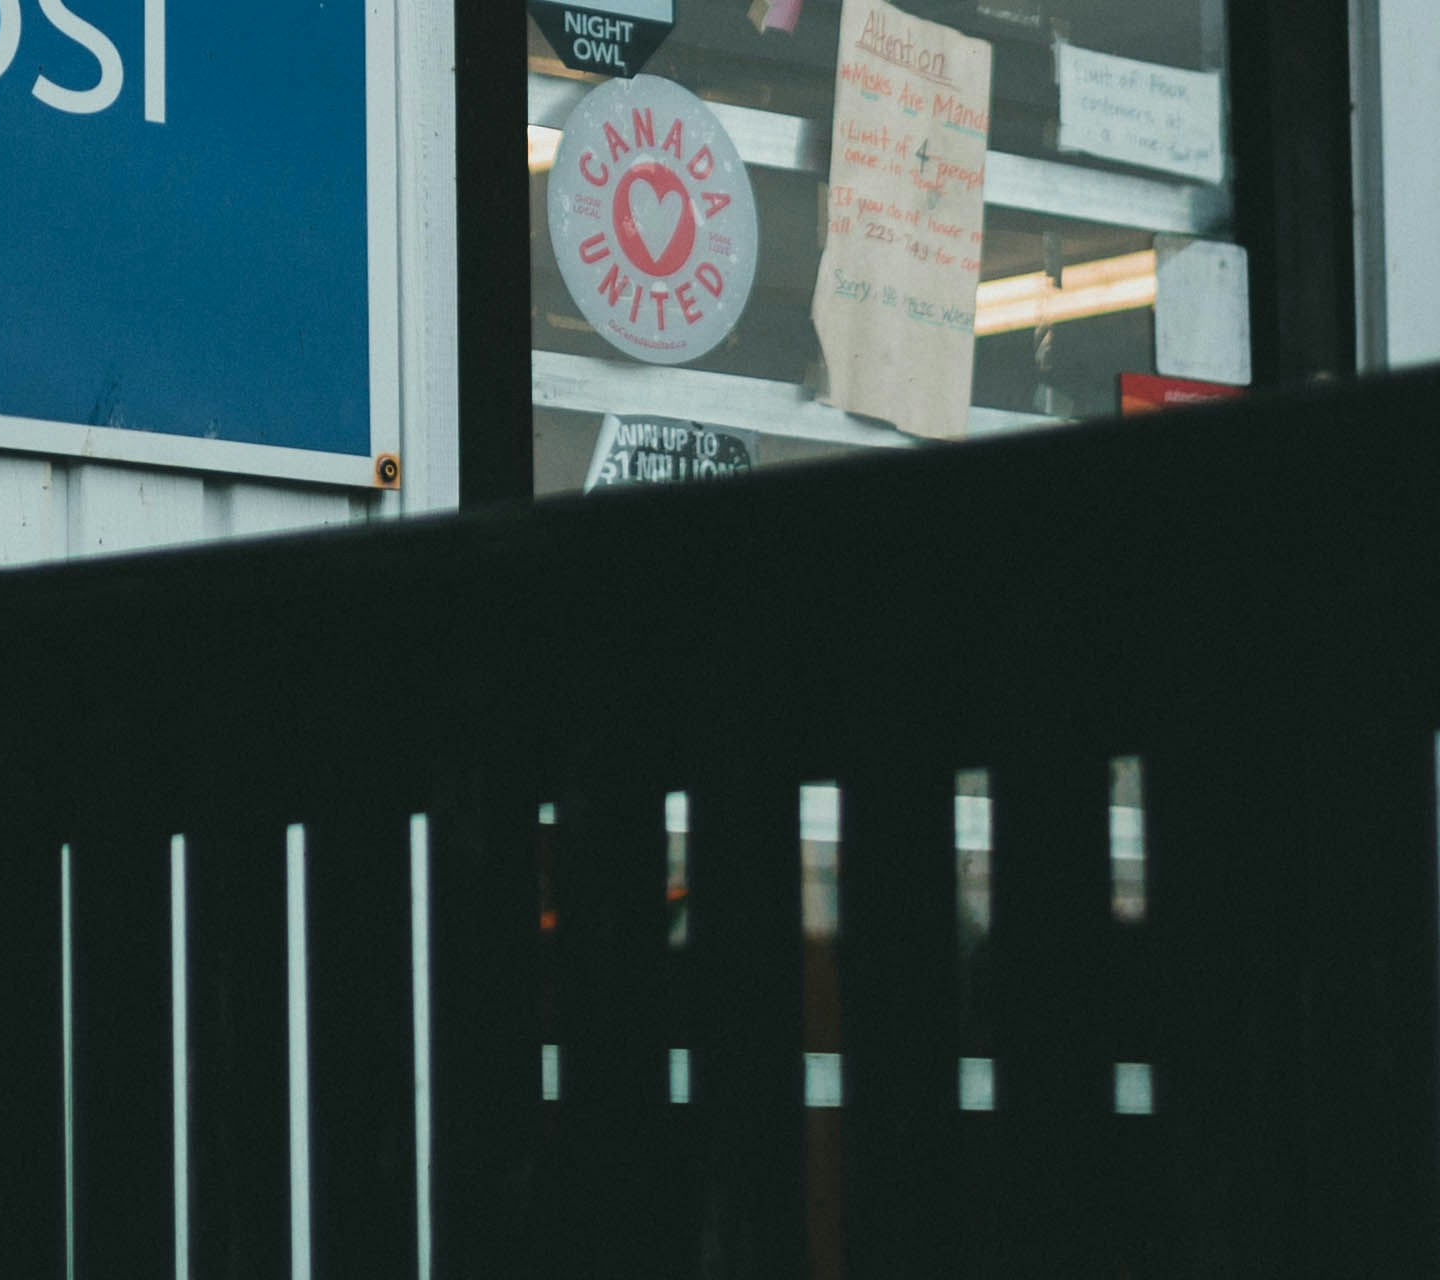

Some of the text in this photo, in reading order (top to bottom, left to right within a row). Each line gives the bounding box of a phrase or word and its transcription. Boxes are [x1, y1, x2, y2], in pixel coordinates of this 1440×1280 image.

[563, 10, 634, 43] NIGHT
[860, 8, 946, 77] Attention
[572, 38, 626, 68] OWL
[579, 107, 732, 220] CANADA
[914, 137, 931, 174] 4
[578, 231, 725, 332] UNITED
[614, 423, 719, 458] WIN UP TO
